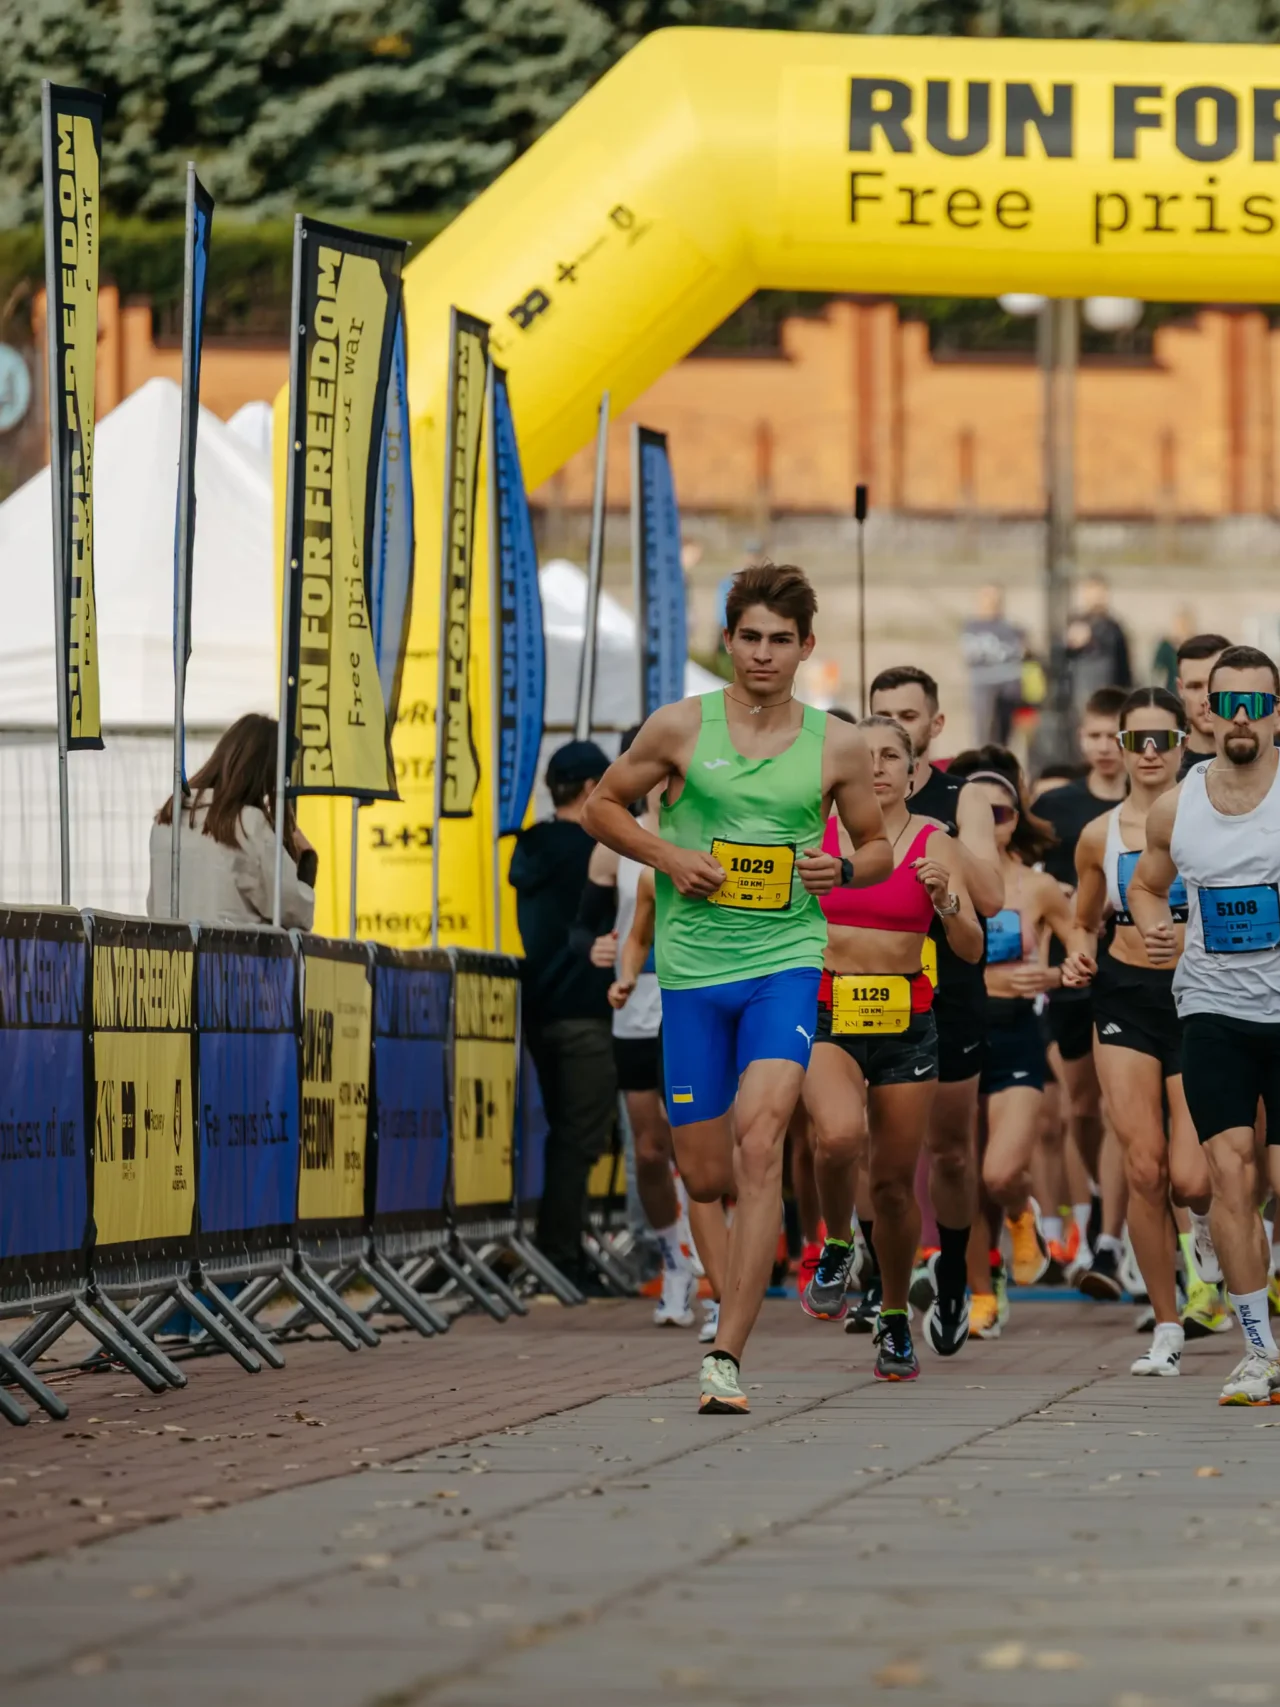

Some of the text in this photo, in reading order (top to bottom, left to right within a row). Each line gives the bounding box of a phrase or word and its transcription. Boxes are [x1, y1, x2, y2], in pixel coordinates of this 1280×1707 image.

[848, 76, 1076, 158] RUN
[849, 170, 1034, 230] Free
[344, 316, 365, 376] war
[300, 245, 342, 787] RUN FOR FREEDOM
[347, 651, 367, 727] Free
[730, 857, 775, 875] 1029
[740, 879, 763, 888] 10 KM
[1216, 899, 1258, 917] 5108
[136, 948, 194, 1031] FREEDOM
[852, 987, 890, 1002] 1129
[860, 1007, 881, 1015] 10 KM
